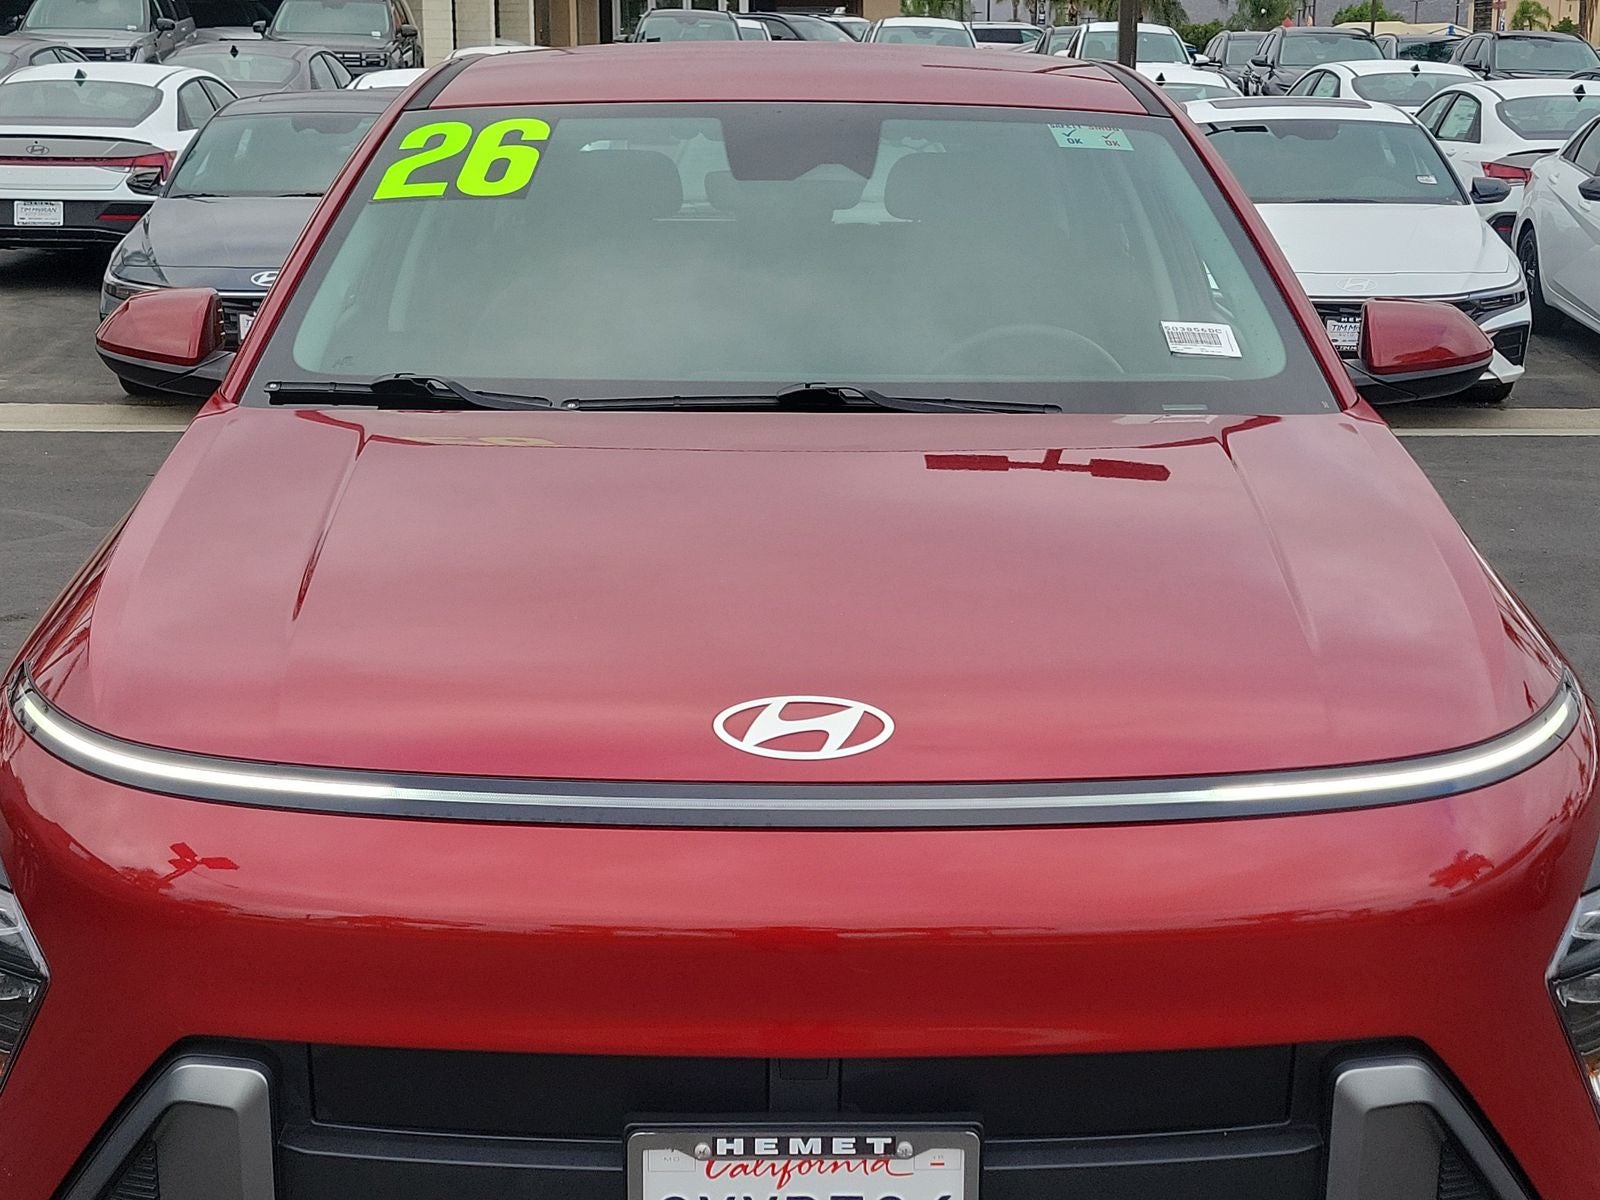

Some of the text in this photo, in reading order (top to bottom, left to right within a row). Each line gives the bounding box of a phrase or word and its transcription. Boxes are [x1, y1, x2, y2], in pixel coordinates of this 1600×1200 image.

[1066, 137, 1083, 145] OK
[373, 118, 550, 200] 26
[716, 1137, 893, 1155] HEMET
[704, 1158, 914, 1190] California
